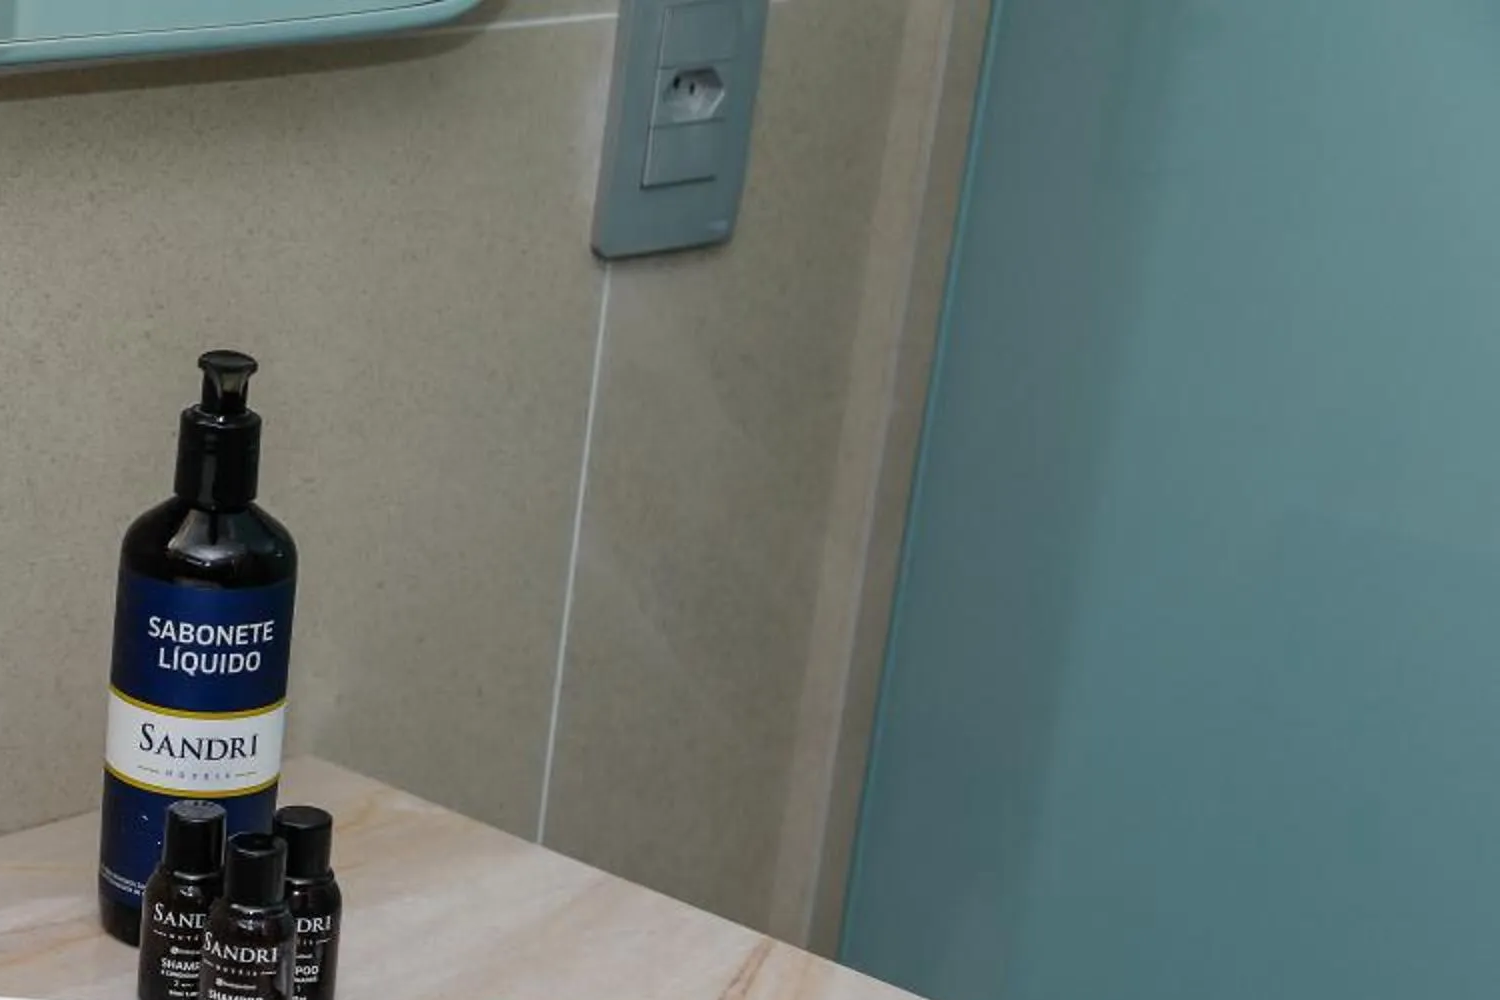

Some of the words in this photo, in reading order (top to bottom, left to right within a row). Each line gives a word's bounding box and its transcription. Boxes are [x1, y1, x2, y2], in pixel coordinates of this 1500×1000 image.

[148, 616, 275, 647] SABONETE
[158, 646, 261, 676] LÍQUIDO
[153, 902, 207, 929] SAND
